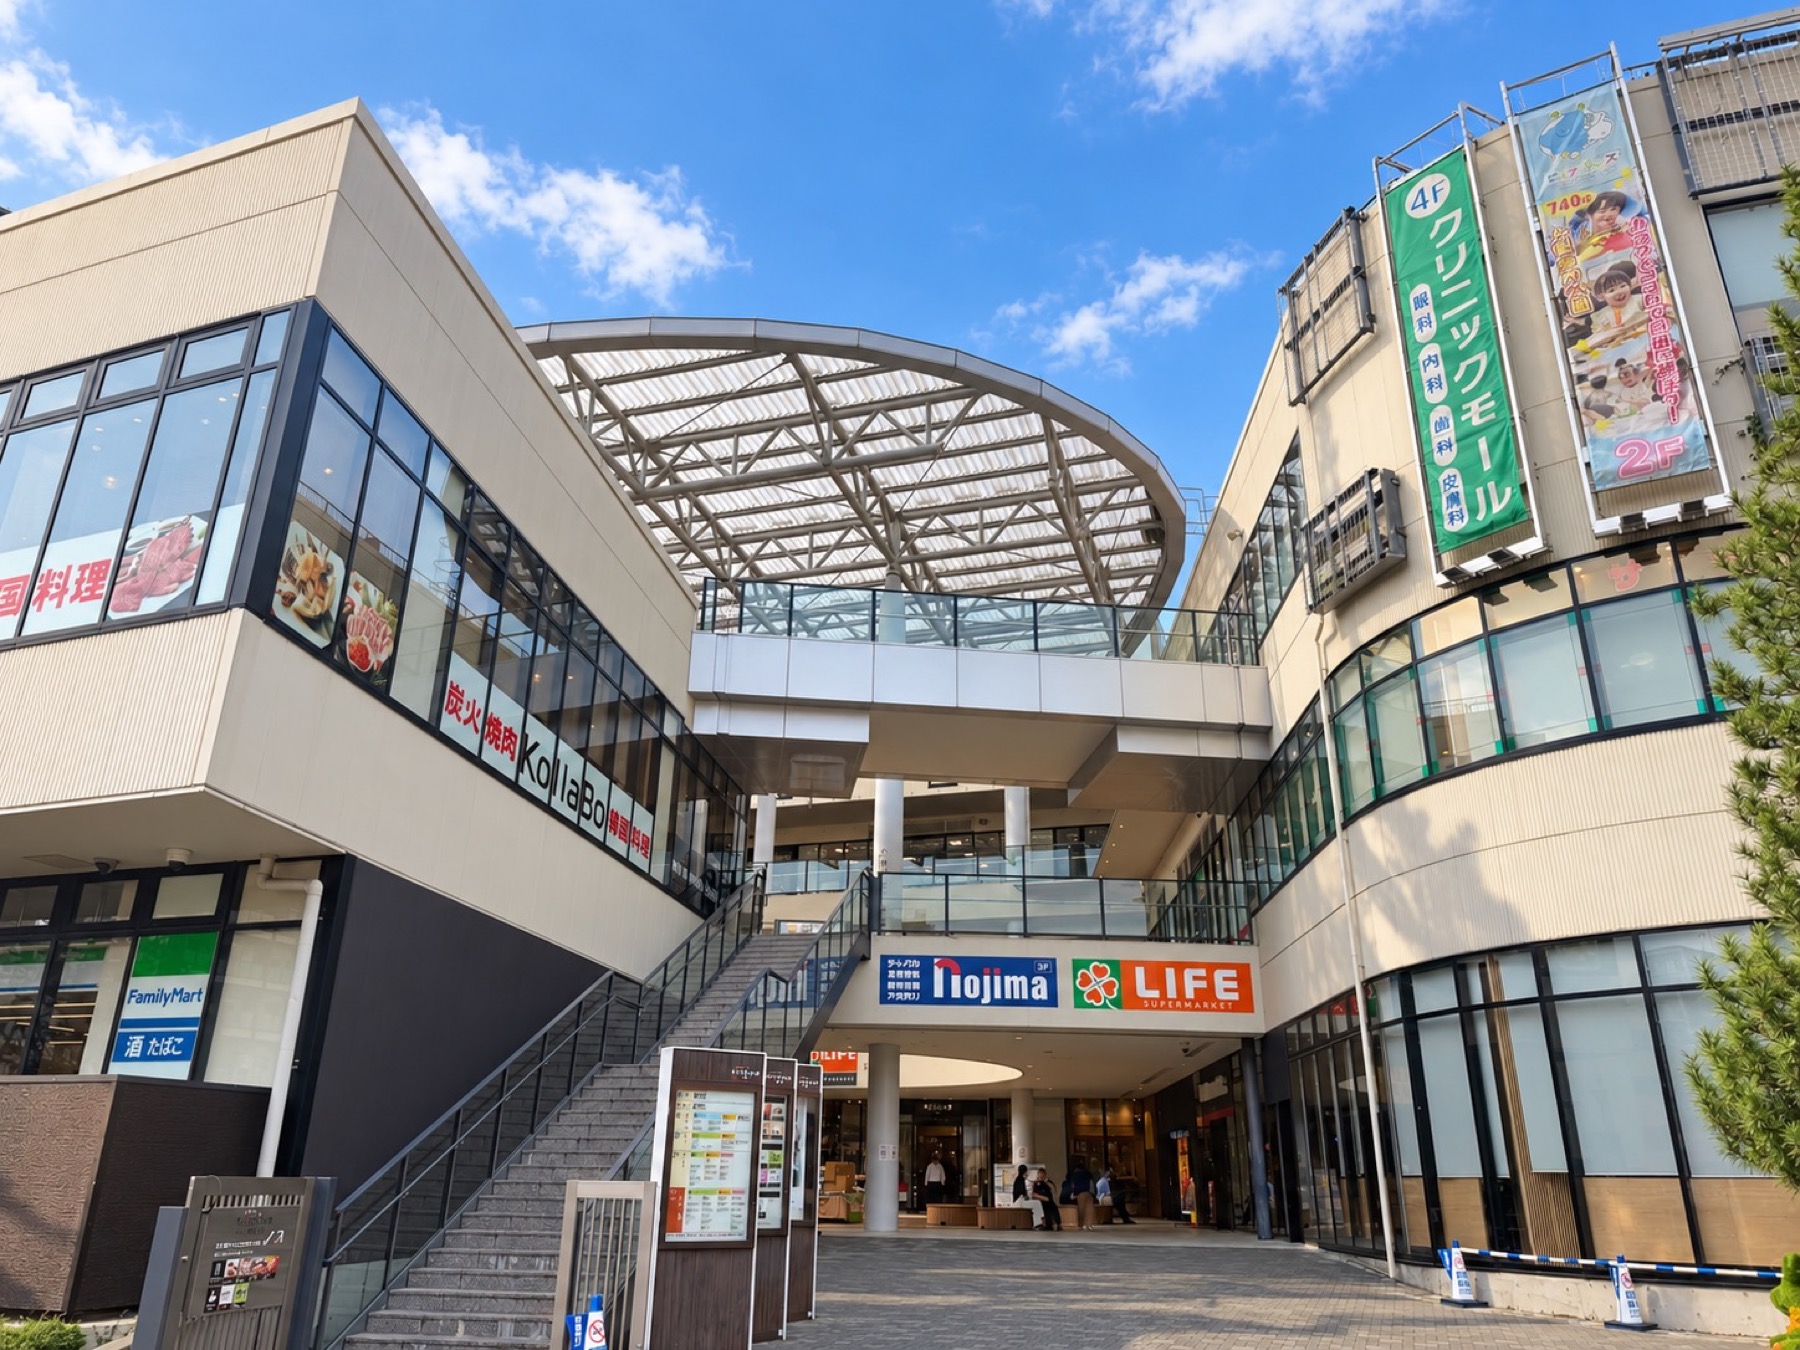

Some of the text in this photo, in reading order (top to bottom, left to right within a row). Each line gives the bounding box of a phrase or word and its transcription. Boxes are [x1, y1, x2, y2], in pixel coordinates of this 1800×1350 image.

[1411, 179, 1447, 212] 4F
[1422, 353, 1443, 394] 内科
[1429, 207, 1513, 522] クリニックモール
[1615, 434, 1685, 480] 2F
[519, 731, 606, 830] KollaBo
[127, 986, 204, 1008] FamilyMart
[1134, 966, 1240, 1001] LIFE
[1143, 999, 1234, 1010] SUPERMARKET
[124, 1034, 185, 1058] 酒 たばこ
